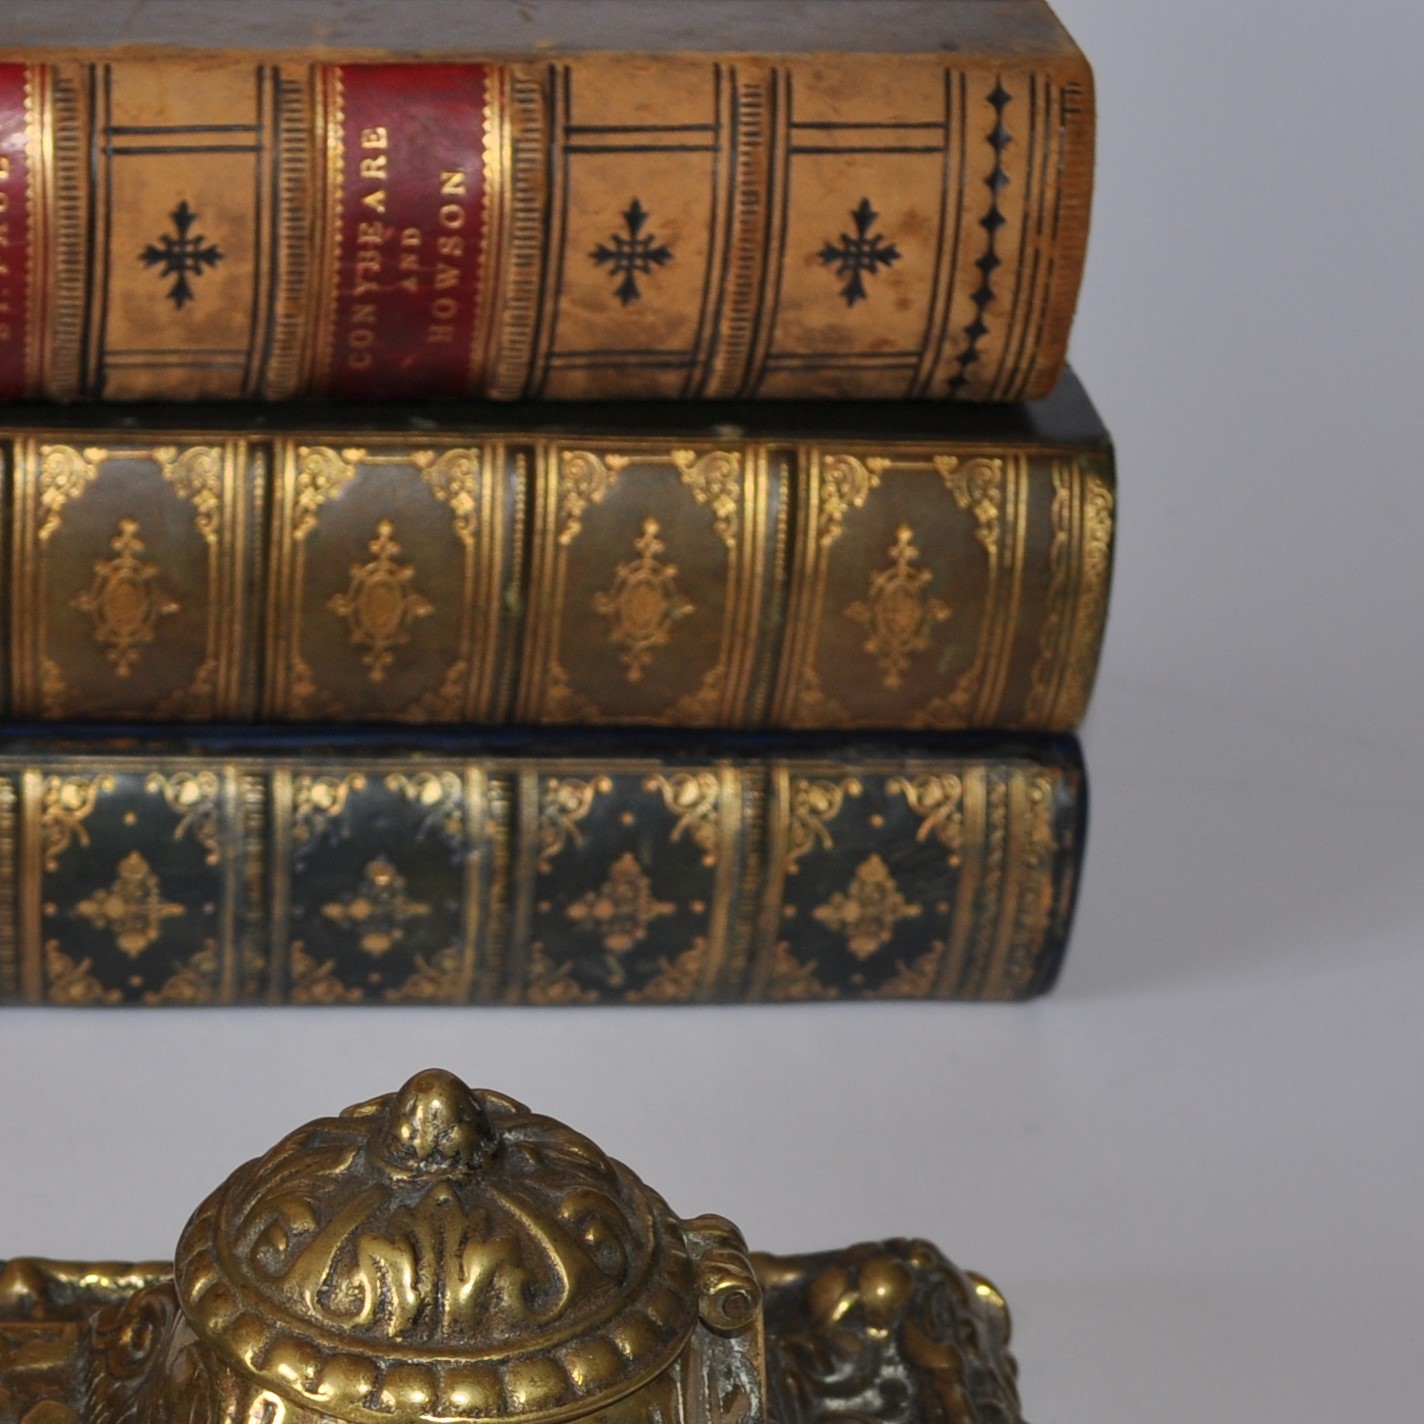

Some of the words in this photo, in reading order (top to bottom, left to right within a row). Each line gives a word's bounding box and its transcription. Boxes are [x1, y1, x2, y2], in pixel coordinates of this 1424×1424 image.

[347, 125, 389, 370] CONYBEARE
[399, 227, 422, 294] AND
[429, 169, 467, 344] HOWSON
